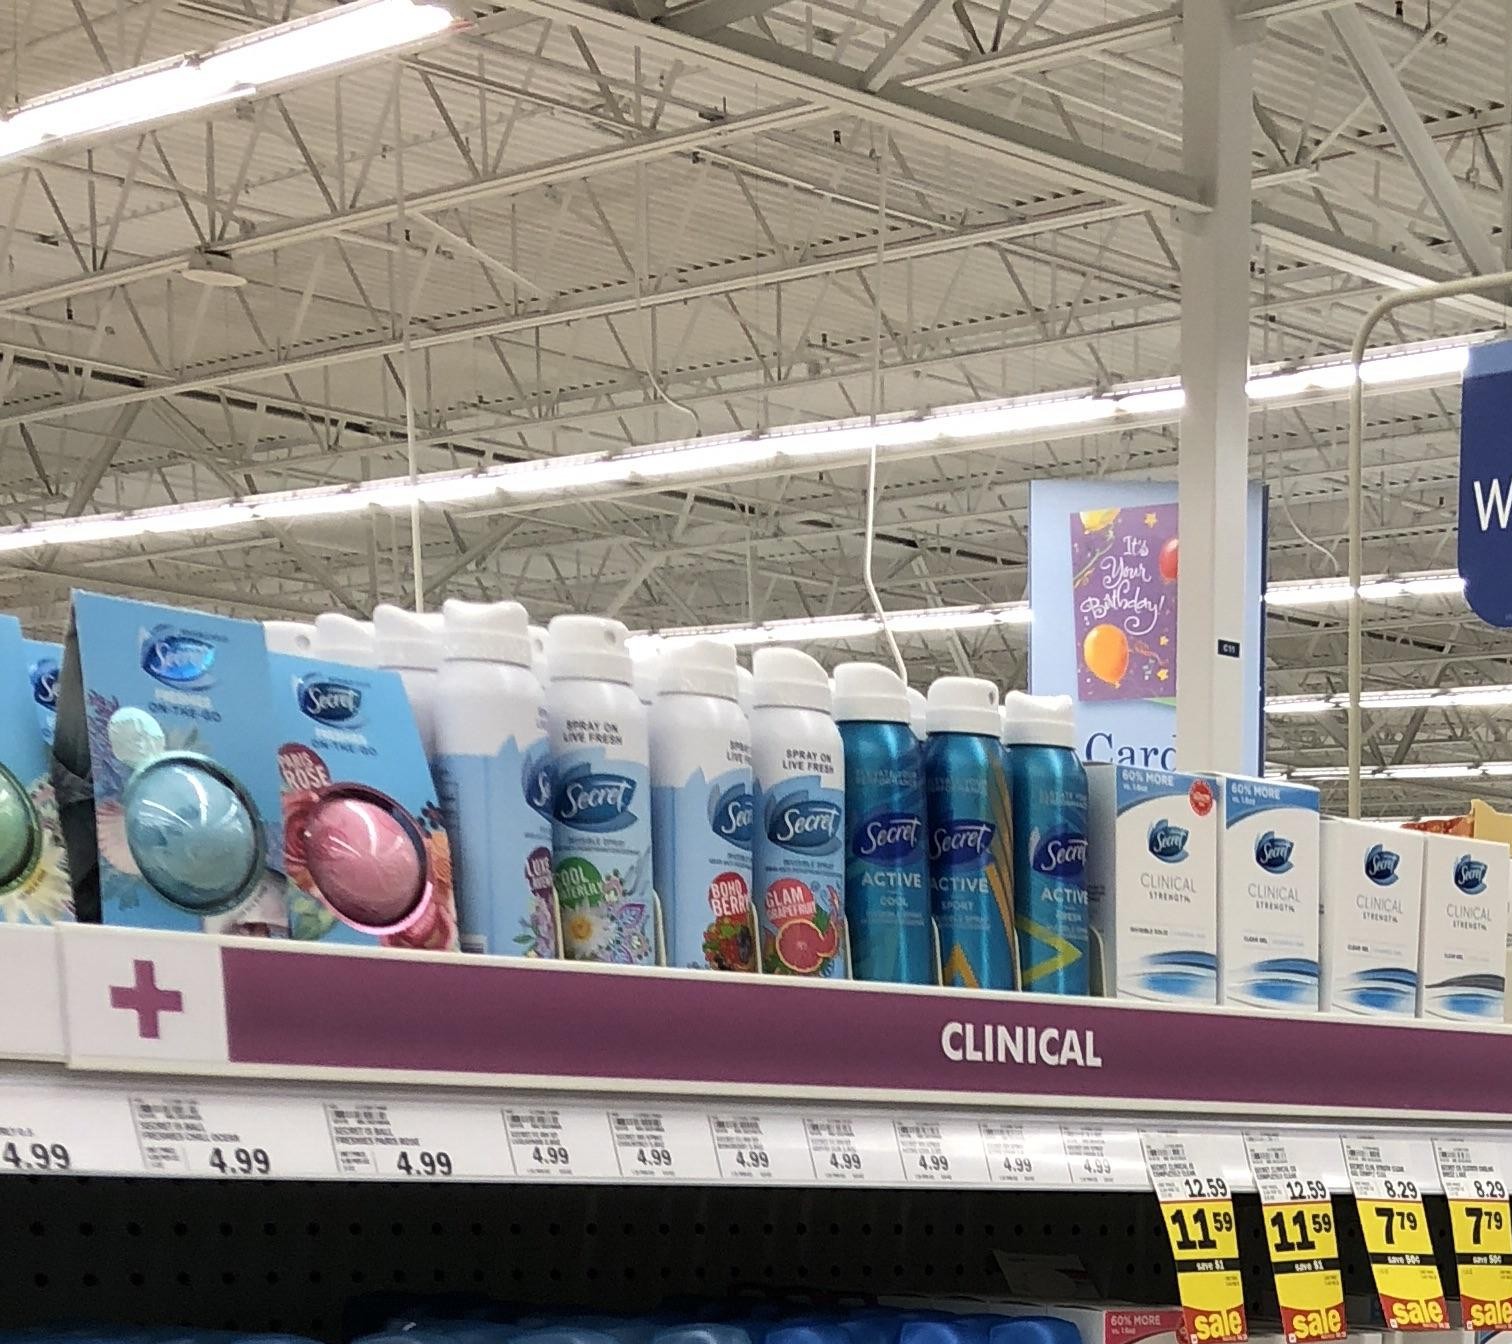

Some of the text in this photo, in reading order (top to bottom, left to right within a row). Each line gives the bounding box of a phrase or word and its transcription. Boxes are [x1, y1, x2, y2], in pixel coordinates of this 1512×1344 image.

[1100, 556, 1152, 589] Your
[1080, 582, 1165, 636] Birthday!
[562, 732, 623, 746] LIVE FRESH
[566, 720, 619, 733] SPRAY ON
[807, 762, 835, 775] FRESH
[560, 781, 631, 813] Secret
[776, 810, 842, 838] Secret
[861, 872, 922, 889] ACTIVE
[941, 1021, 1103, 1068] CLINICAL
[2, 1142, 71, 1170] 4.99
[209, 1148, 271, 1175] 4.99
[397, 1150, 453, 1176] 4.99
[532, 1145, 569, 1166] 4.99
[1185, 1177, 1228, 1198] 12.59
[1286, 1179, 1327, 1200] 12.59
[1384, 1179, 1419, 1199] 8.29
[1475, 1179, 1506, 1199] 8.29
[1111, 1314, 1161, 1326] 60% MORE
[1293, 1307, 1342, 1340] sale
[1391, 1296, 1441, 1326] sale
[1193, 1309, 1243, 1342] sale
